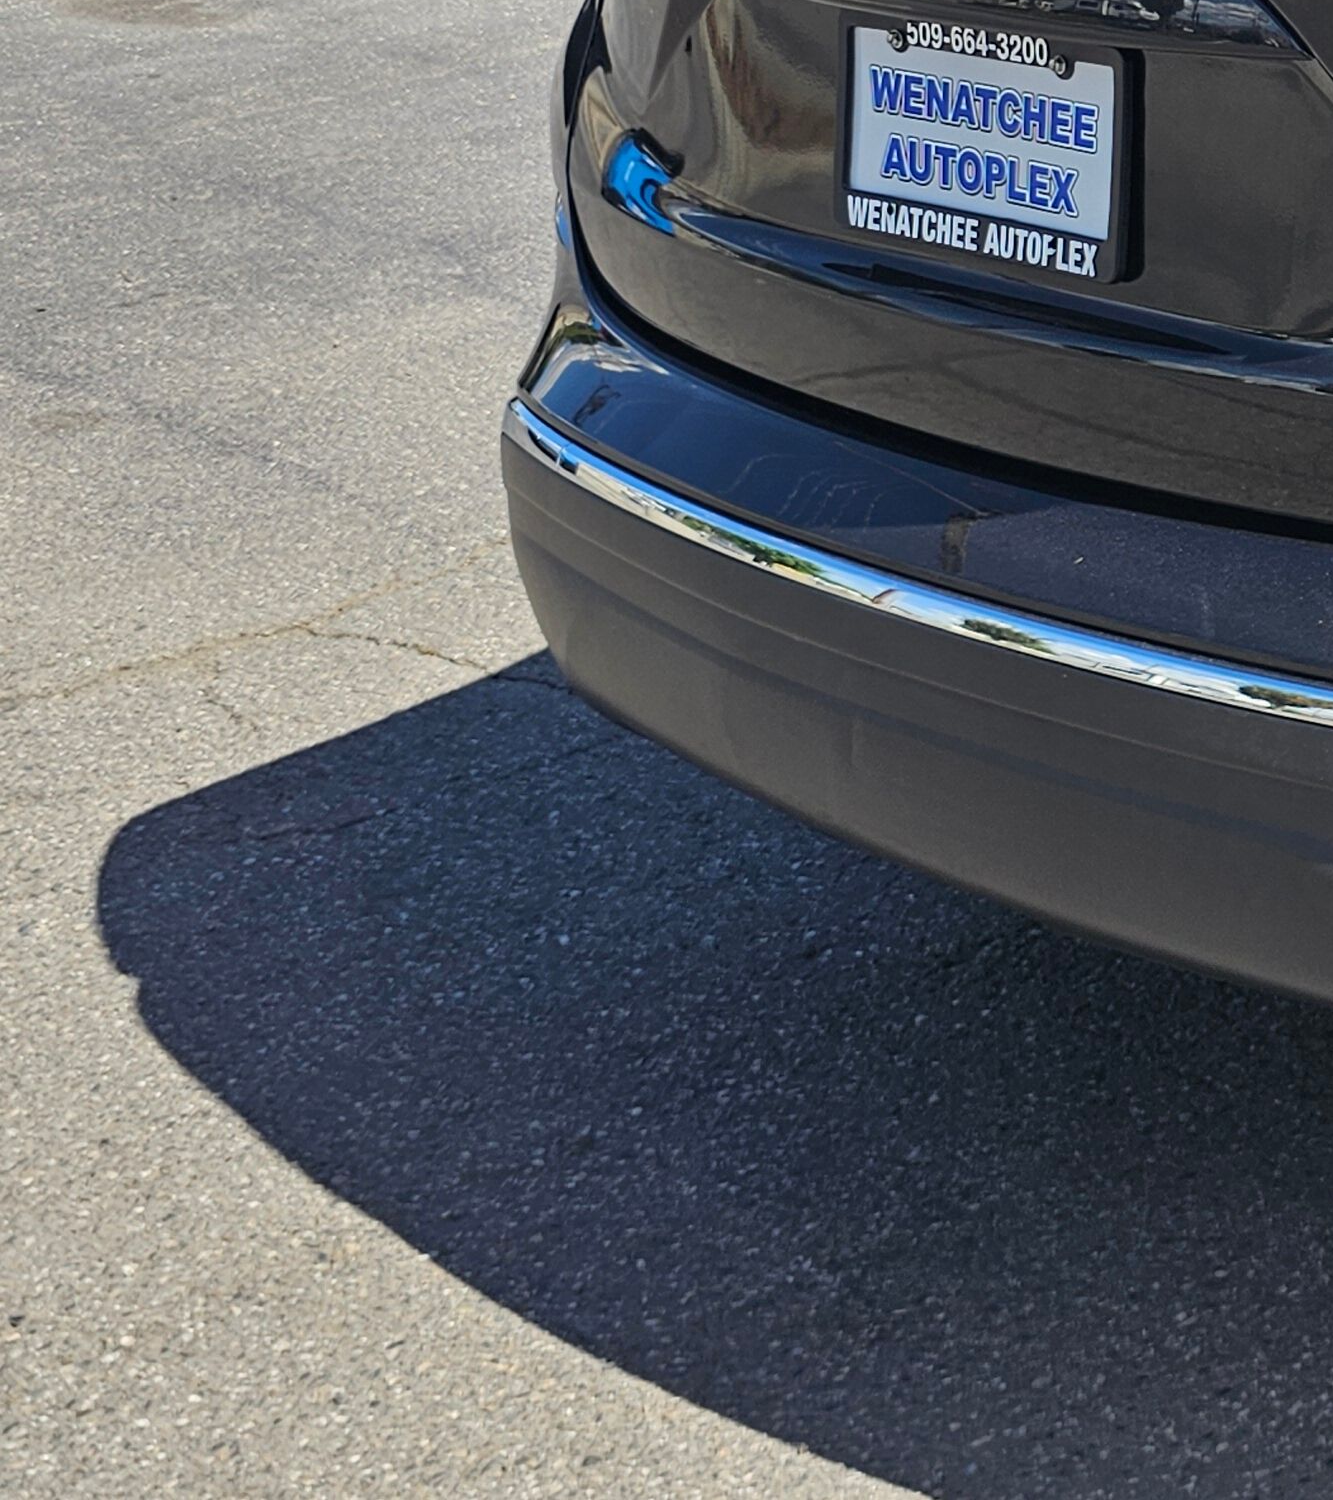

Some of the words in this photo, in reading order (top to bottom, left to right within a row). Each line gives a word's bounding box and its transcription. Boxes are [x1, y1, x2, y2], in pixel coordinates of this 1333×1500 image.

[906, 22, 1048, 67] 509-664-3200
[869, 64, 1099, 154] WENATCHEE
[881, 134, 1079, 217] AUTOPLEX
[847, 194, 979, 252] WENATCHEE
